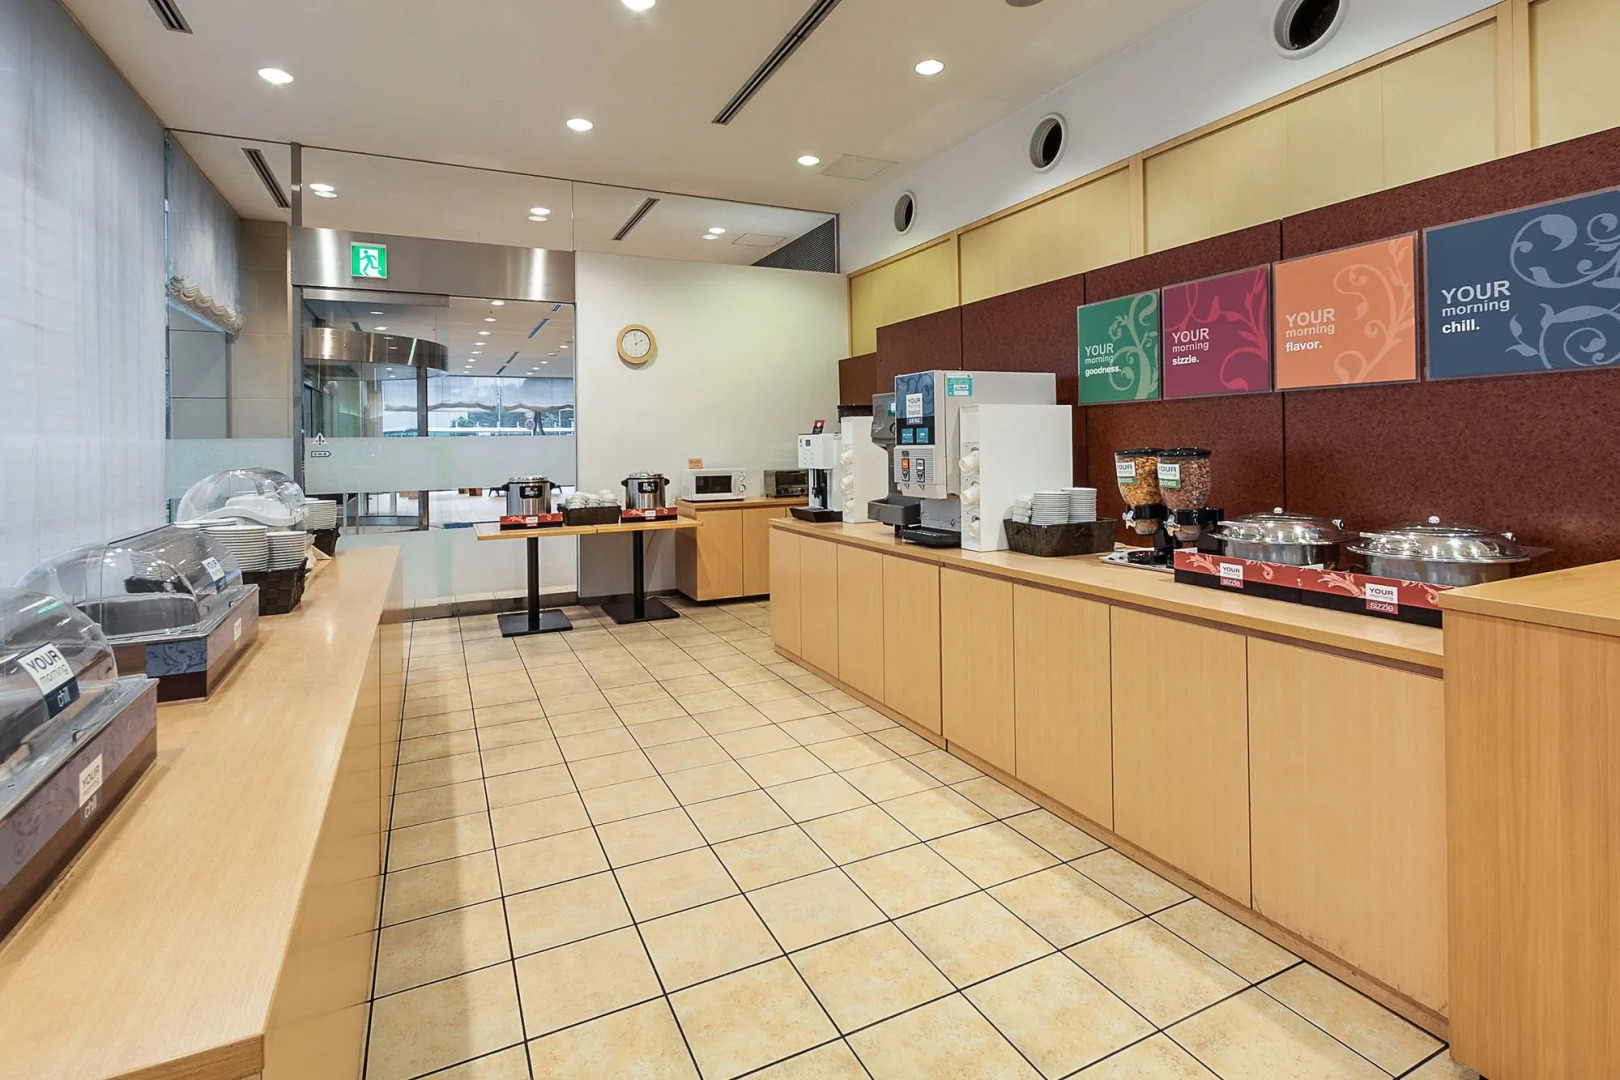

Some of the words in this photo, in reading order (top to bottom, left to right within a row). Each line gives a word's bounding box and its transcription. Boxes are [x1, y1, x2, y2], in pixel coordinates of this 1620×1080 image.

[1441, 280, 1511, 305] YOUR
[1442, 300, 1510, 317] morning
[1285, 308, 1336, 328] YOUR
[1286, 324, 1335, 338] morning
[1442, 319, 1480, 334] chill.
[1172, 328, 1210, 344] YOUR
[1084, 343, 1114, 357] YOUR
[1172, 341, 1209, 354] morning
[1286, 340, 1323, 353] flavor.
[1084, 355, 1114, 365] morning
[1172, 355, 1200, 366] sizzle.
[1085, 365, 1122, 377] goodness.
[1222, 566, 1241, 574] YOUR
[1223, 578, 1241, 588] sizzle
[1369, 587, 1394, 597] YOUR
[1370, 601, 1394, 612] sizzle
[26, 649, 62, 674] YOUR
[39, 664, 69, 686] morning
[57, 686, 71, 708] chill
[82, 764, 100, 790] YOUR
